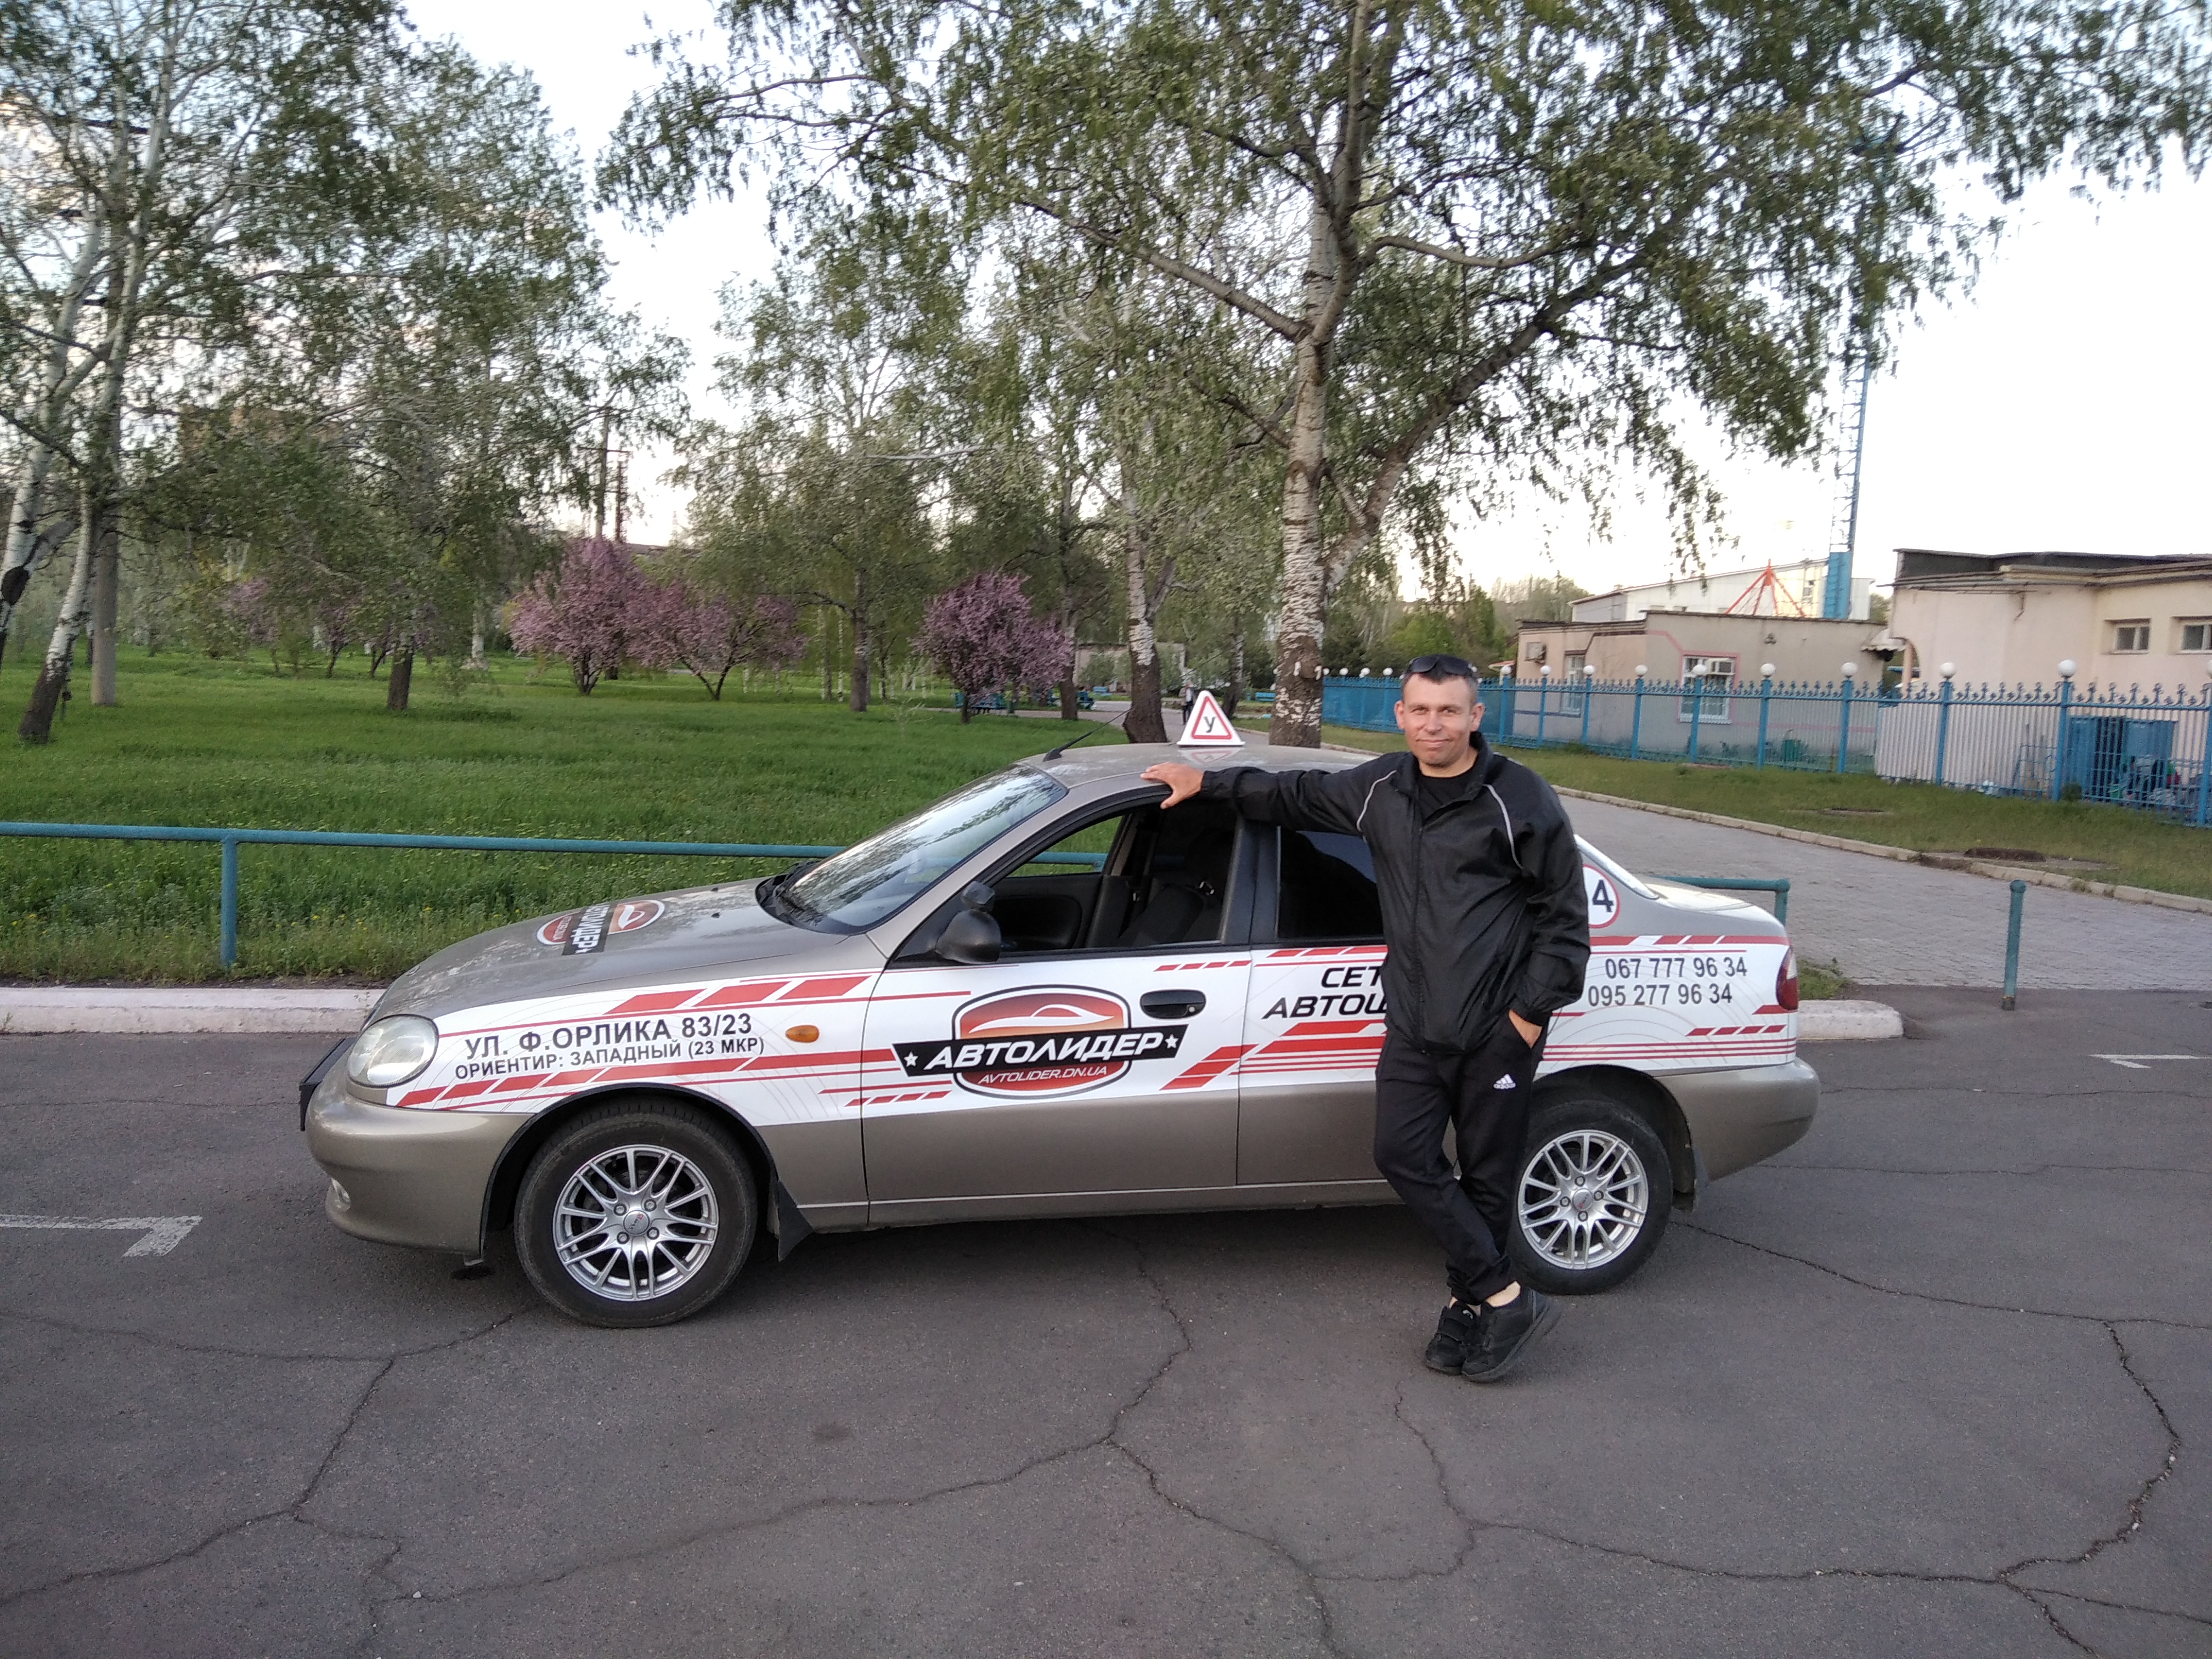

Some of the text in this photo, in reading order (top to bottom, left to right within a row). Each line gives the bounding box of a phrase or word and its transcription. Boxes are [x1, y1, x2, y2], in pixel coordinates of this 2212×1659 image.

[1592, 879, 1613, 912] 4
[1605, 957, 1747, 979] 067 777 96 34
[1588, 983, 1733, 1006] 095 277 96 34
[465, 1035, 508, 1059] УЛ.
[682, 1013, 752, 1037] 83/23
[923, 1032, 1164, 1070] АВТОЛИДЕР
[455, 1036, 764, 1079] ОРИЕНТИР: ЗАПАДНЫЙ (23 МКР)
[978, 1065, 1107, 1084] AVTOLIDER.DN.UA
